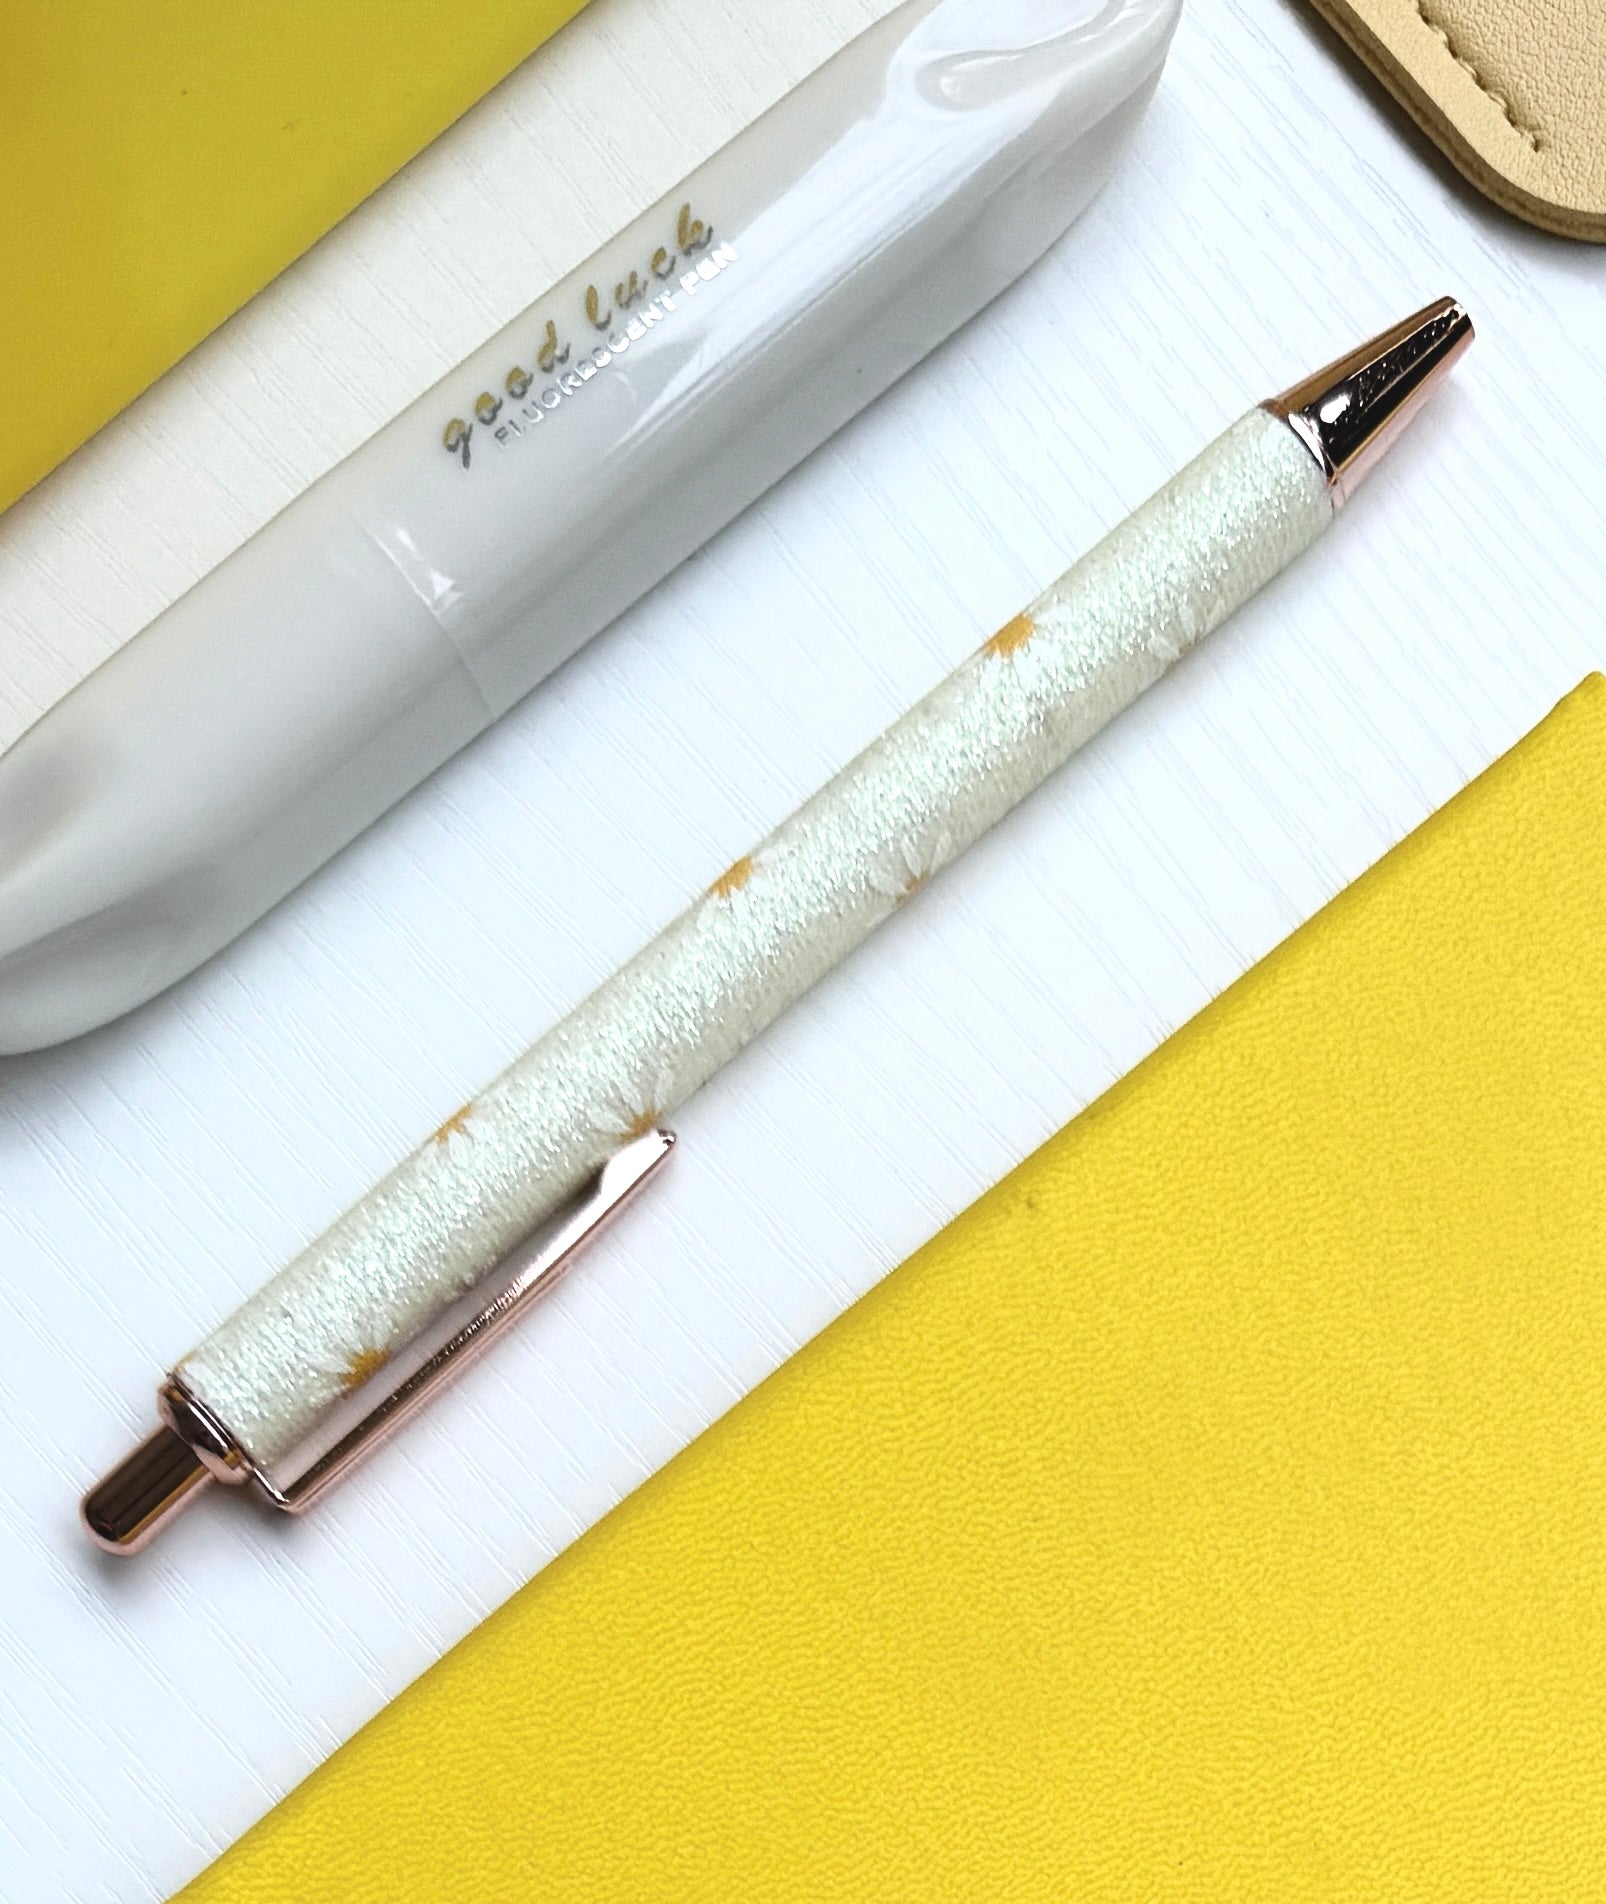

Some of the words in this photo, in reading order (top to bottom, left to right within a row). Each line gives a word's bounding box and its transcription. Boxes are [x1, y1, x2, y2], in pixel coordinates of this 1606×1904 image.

[441, 319, 571, 470] good
[584, 202, 714, 332] luck
[678, 242, 740, 296] PEN
